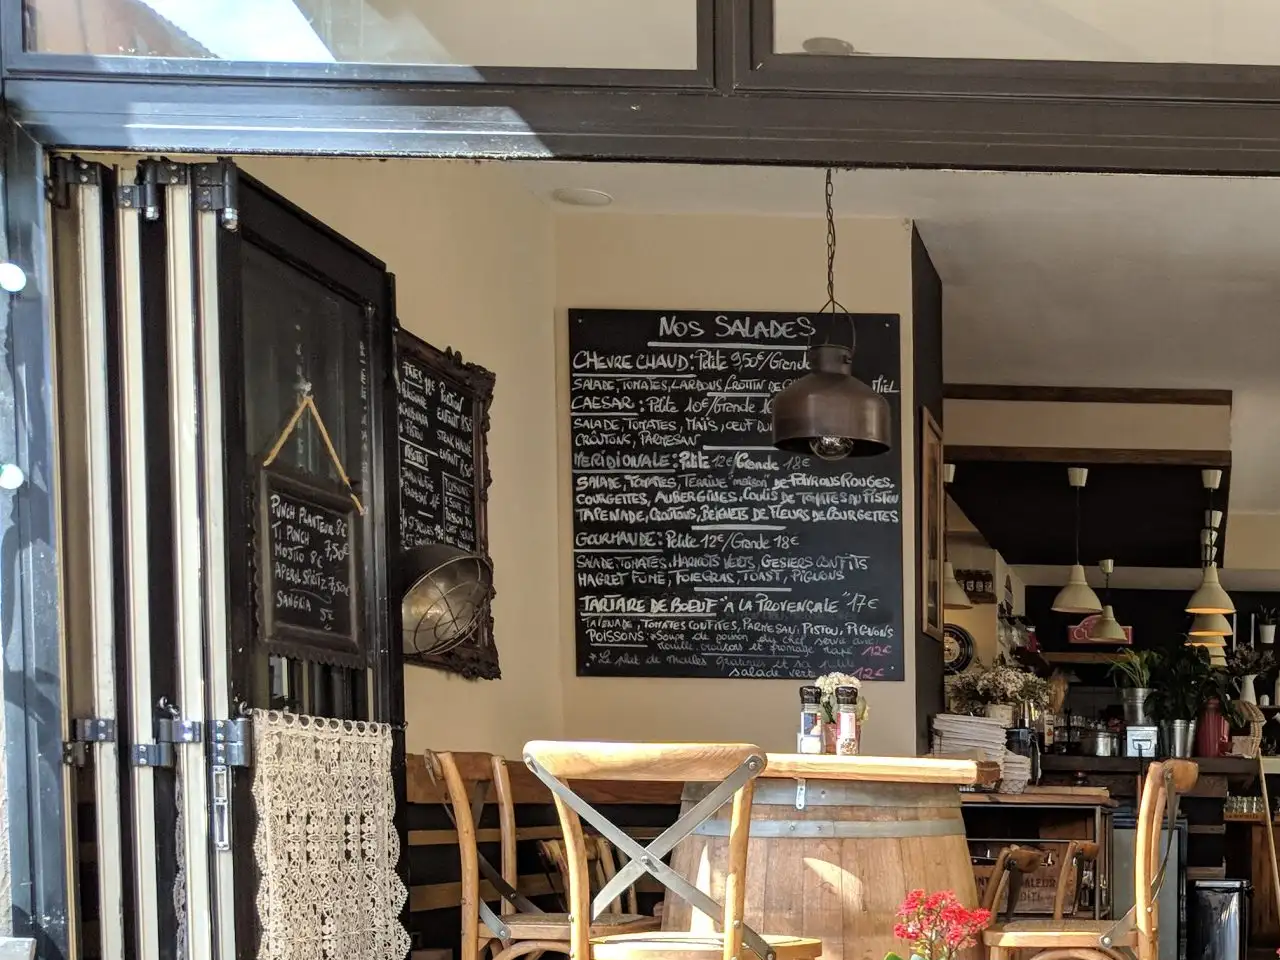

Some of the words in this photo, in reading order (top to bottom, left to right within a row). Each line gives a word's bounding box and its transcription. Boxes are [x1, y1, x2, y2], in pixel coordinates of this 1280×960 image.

[659, 315, 705, 337] NOS
[715, 315, 817, 339] SALADES
[783, 456, 812, 471] 18€
[270, 493, 296, 519] PUNCH
[298, 506, 335, 536] PLANTEUR
[286, 525, 310, 546] PUNCH
[773, 534, 800, 549] 18€
[276, 590, 312, 612] SANGRIA
[578, 594, 646, 613] TARTARE
[650, 598, 668, 613] DE
